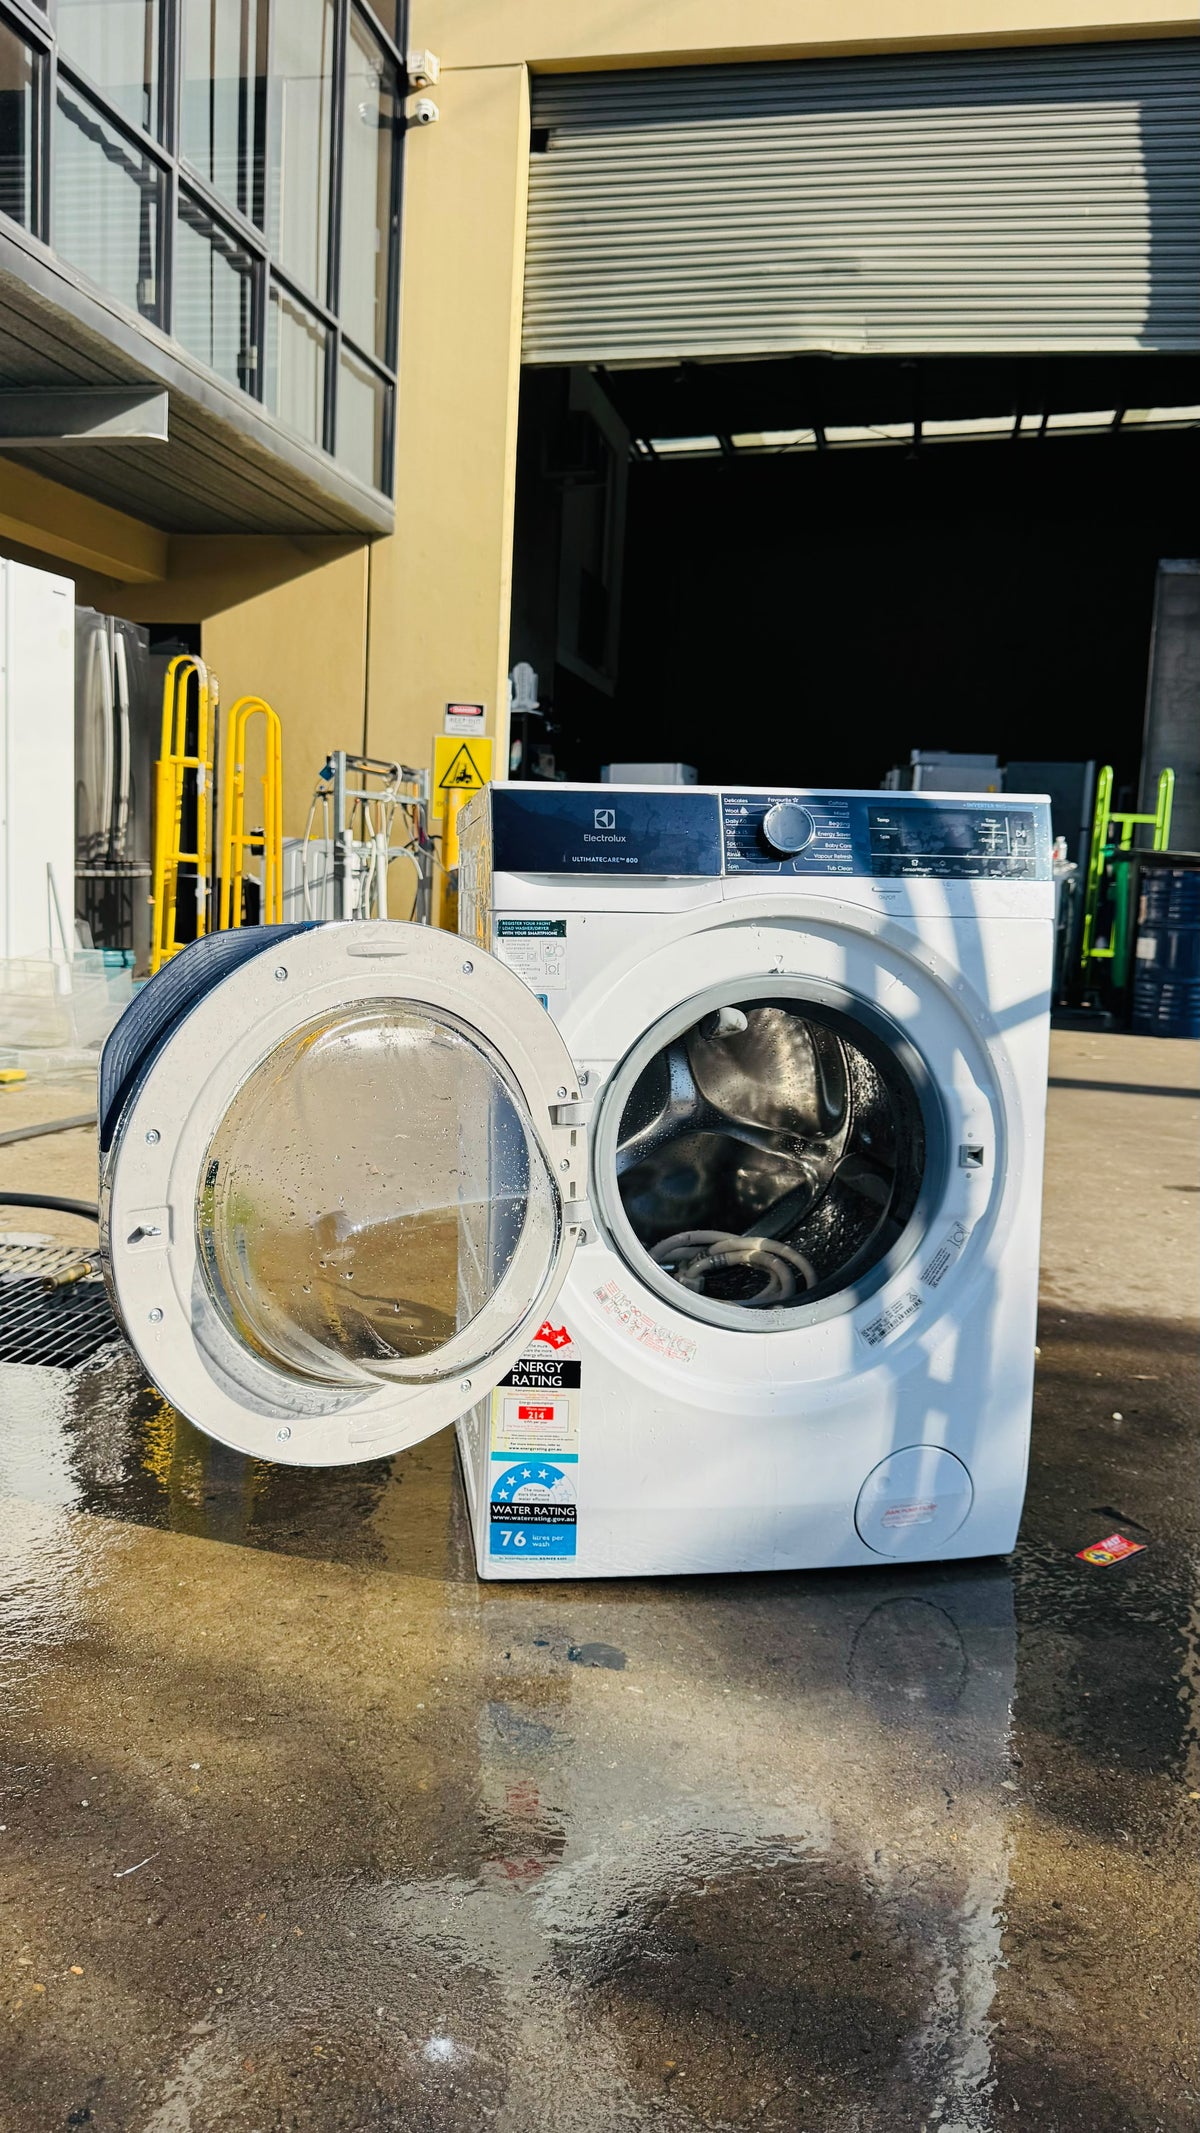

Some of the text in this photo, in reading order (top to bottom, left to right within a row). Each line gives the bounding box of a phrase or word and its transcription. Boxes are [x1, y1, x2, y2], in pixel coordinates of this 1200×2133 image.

[583, 834, 627, 843] Electrolux
[512, 1361, 564, 1373] ENERGY
[511, 1374, 563, 1387] RATING
[527, 1411, 545, 1420] 214
[492, 1505, 575, 1516] WATER RATING
[492, 1515, 575, 1523] www.waterrating.gov.au
[500, 1530, 527, 1547] 76
